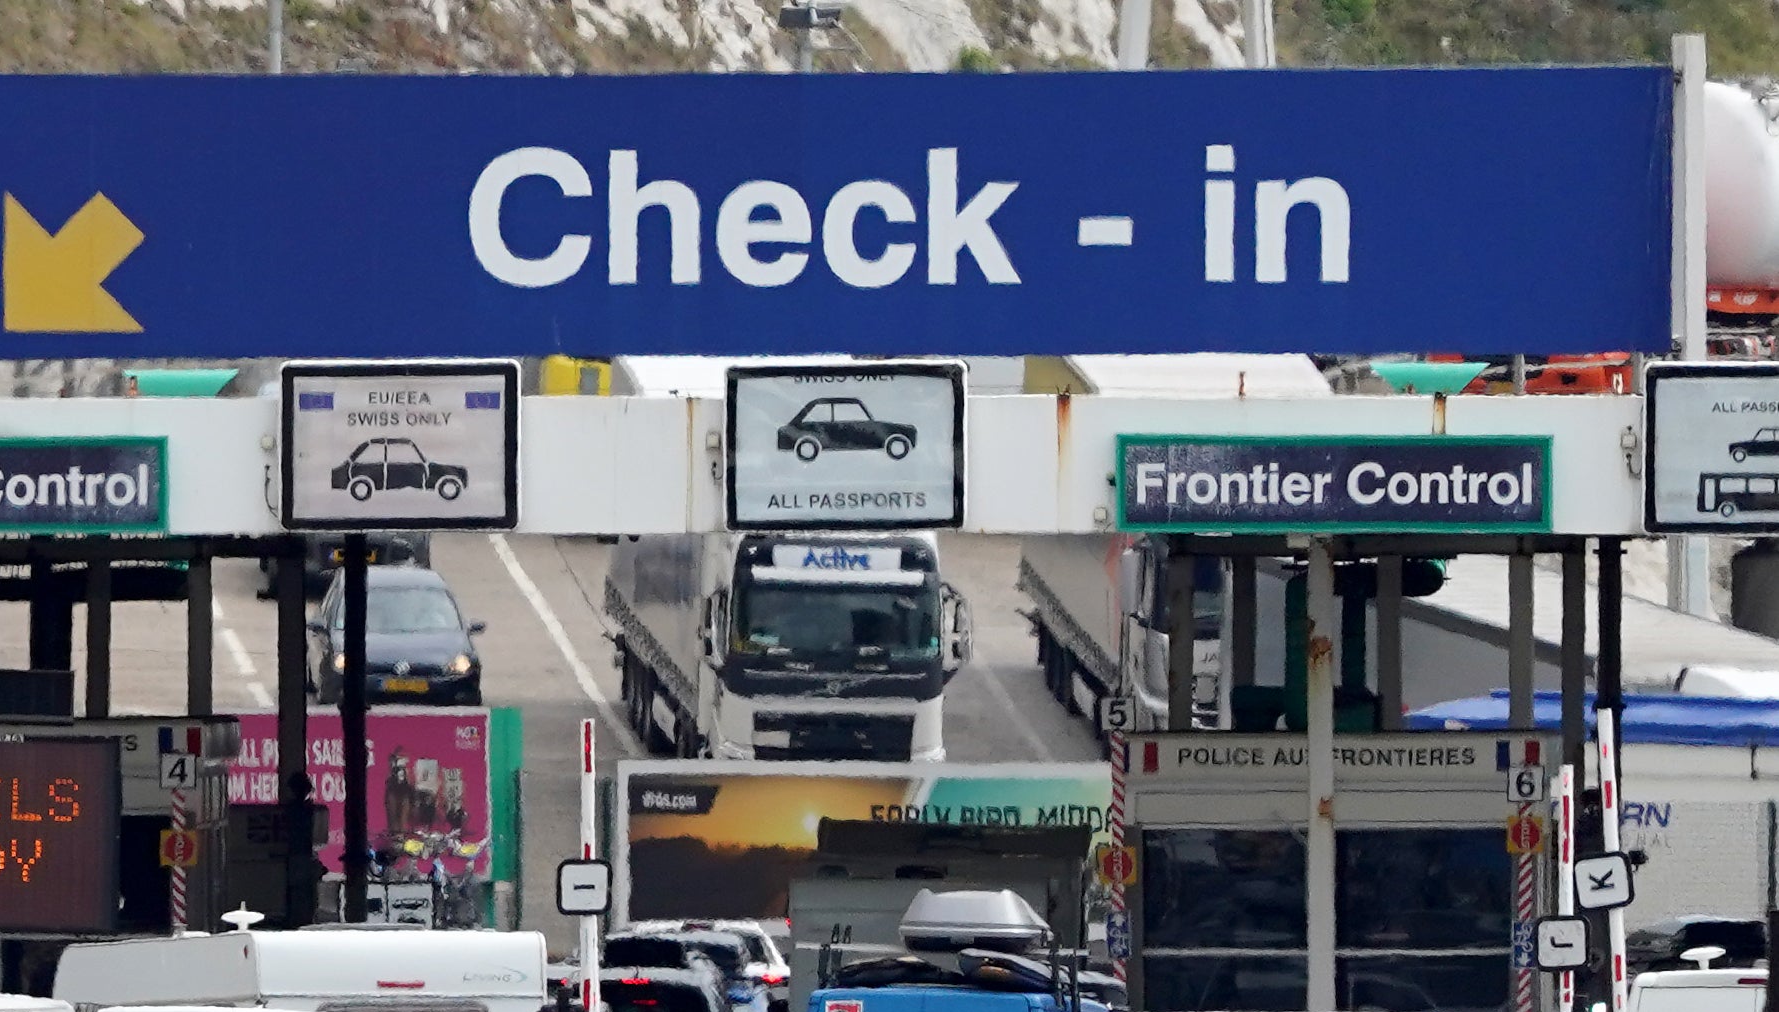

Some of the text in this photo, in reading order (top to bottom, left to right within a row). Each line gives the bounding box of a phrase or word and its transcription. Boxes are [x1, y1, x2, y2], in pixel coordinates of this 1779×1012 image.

[468, 146, 1022, 287] Check
[1205, 144, 1350, 283] in
[368, 391, 431, 405] EU/EEA
[1711, 402, 1737, 413] ALL
[347, 412, 452, 427] SWISS ONLY
[1136, 461, 1533, 505] Frontier Control
[768, 492, 927, 509] ALL PASSPORTS
[1108, 701, 1126, 725] 5
[1178, 746, 1476, 767] POLICE AU FRONTIERES
[169, 758, 187, 784] 4
[1515, 772, 1535, 797] 6
[1588, 867, 1615, 891] K
